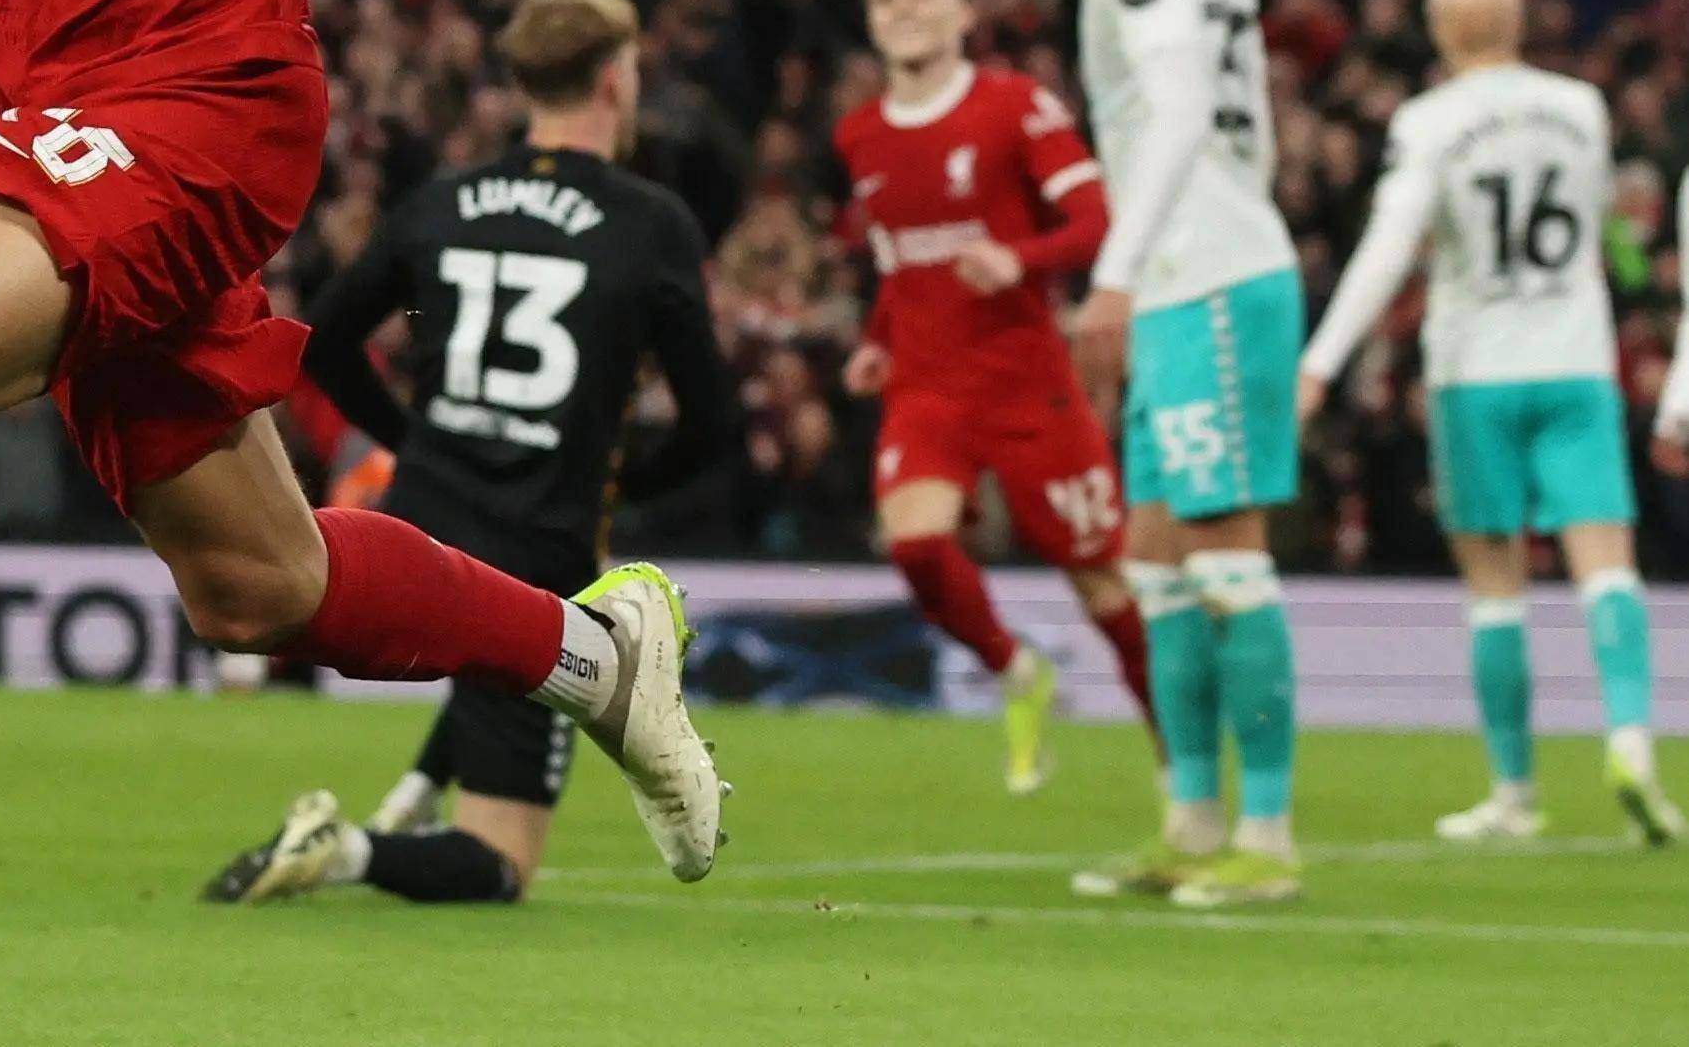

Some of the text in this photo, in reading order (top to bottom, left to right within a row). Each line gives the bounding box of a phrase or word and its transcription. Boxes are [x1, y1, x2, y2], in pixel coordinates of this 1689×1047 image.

[456, 176, 605, 237] LUMLEY
[1472, 164, 1582, 275] 16
[438, 247, 589, 410] 13
